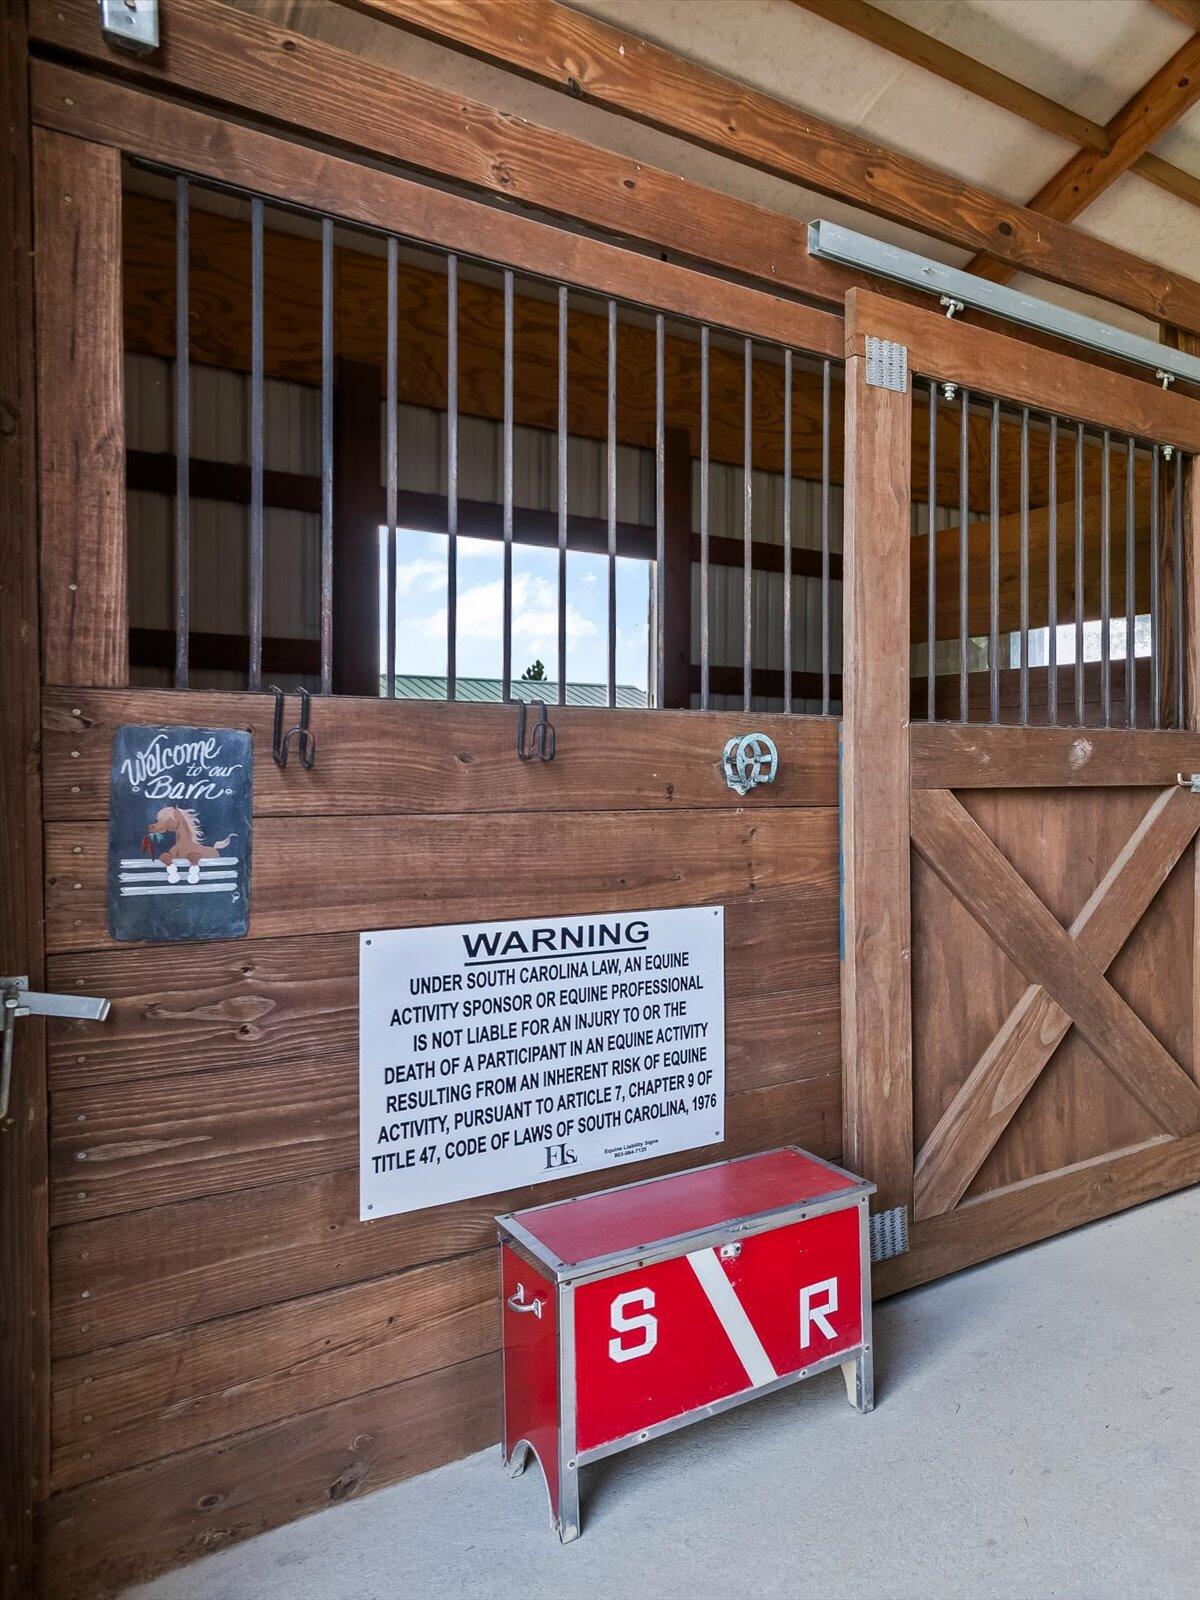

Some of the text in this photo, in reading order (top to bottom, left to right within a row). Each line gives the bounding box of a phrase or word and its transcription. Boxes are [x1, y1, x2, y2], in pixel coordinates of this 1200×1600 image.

[121, 734, 222, 786] Welcome
[186, 763, 242, 777] to our
[145, 775, 224, 799] Barn
[462, 920, 649, 958] WARNING
[410, 952, 689, 995] UNDER SOUTH CAROLINA LAW, AN EQUINE
[390, 975, 703, 1026] ACTIVITY SPONSOR OR EQUINE PROFESSIONAL
[414, 1001, 686, 1052] IS NOT LIABLE FOR AN INJURY TO OR THE
[385, 1022, 708, 1084] DEATH OF A PARTICIPANT IN AN EQUINE ACTIVITY
[387, 1047, 706, 1113] RESULTING FROM AN INHERENT RISK OF EQUINE
[378, 1070, 712, 1144] ACTIVITY, PURSUANT TO ARTICLE 7, CHAPTER 9 OF
[372, 1093, 716, 1173] TITLE 47, CODE OF LAWS OF SOUTH CAROLINA, 1976
[609, 1277, 837, 1363] S R
